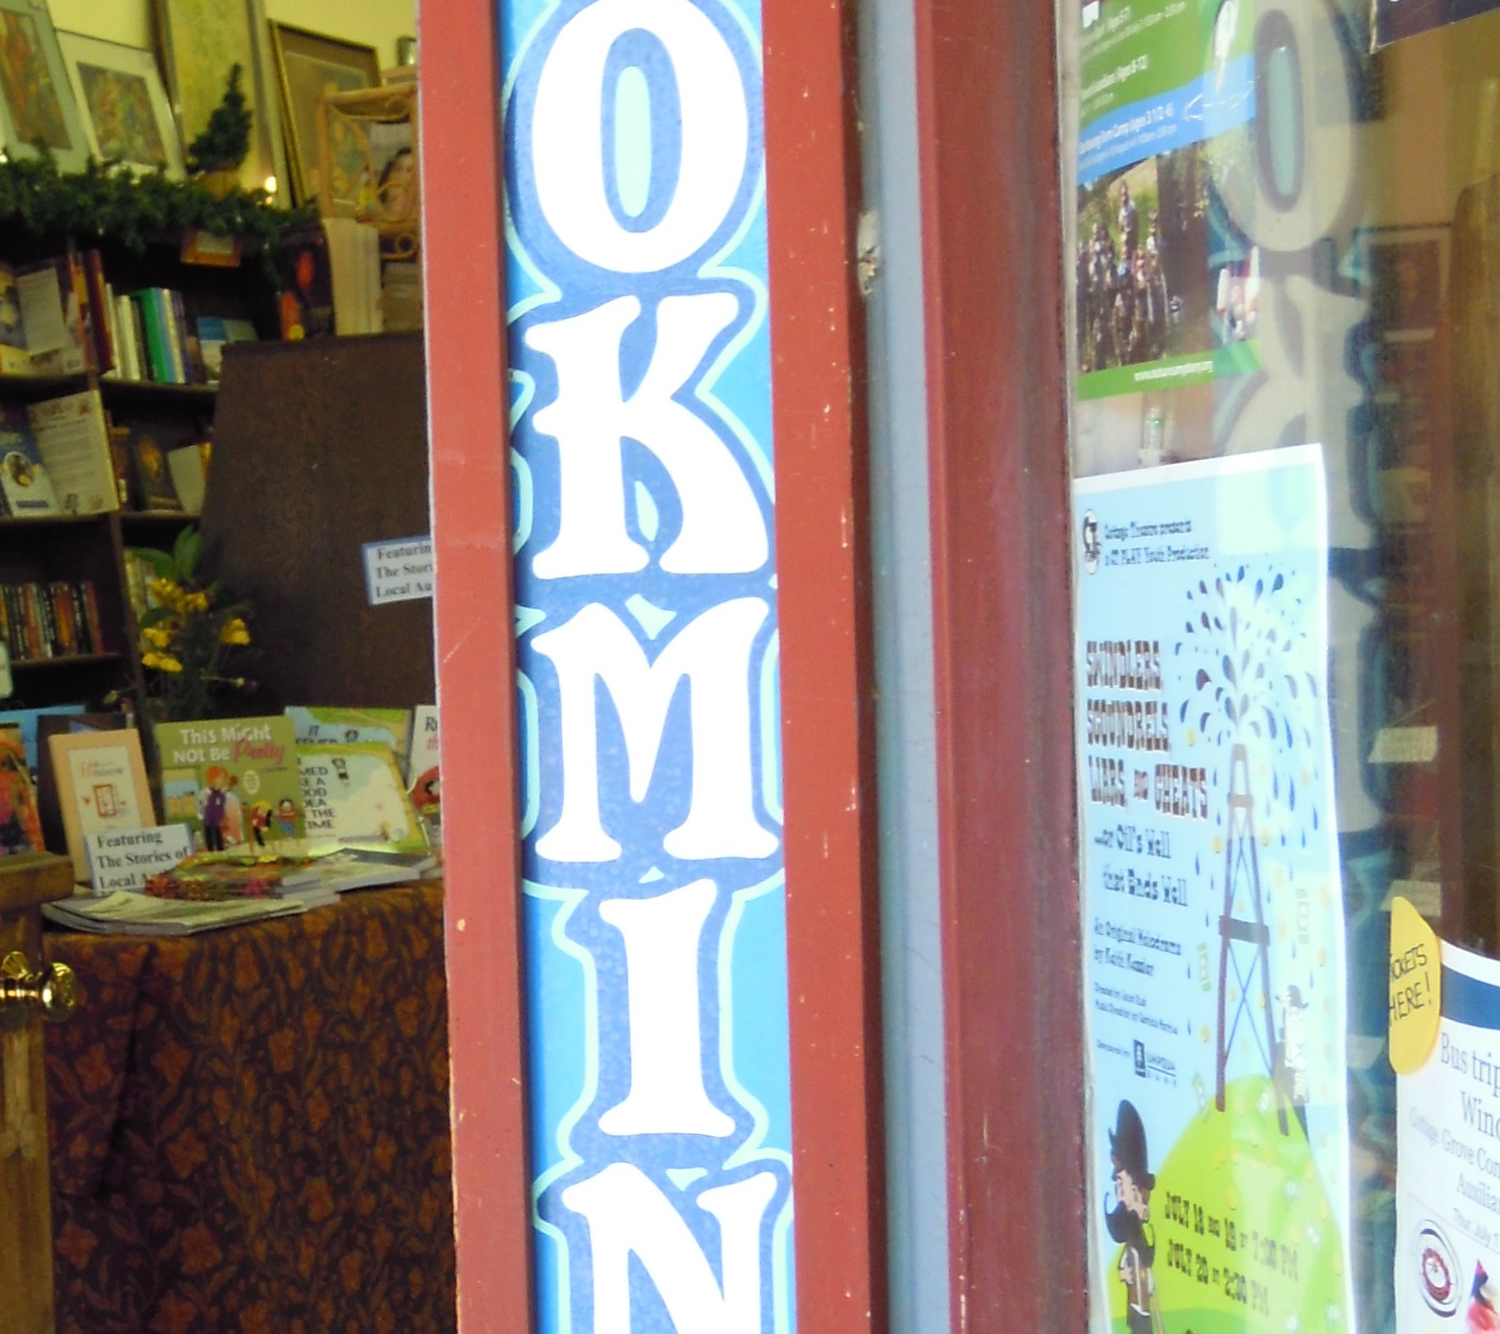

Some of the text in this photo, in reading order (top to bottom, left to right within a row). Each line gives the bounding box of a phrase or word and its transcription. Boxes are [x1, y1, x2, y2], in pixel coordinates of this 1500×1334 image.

[377, 543, 431, 560] Featurin
[180, 724, 272, 745] This Might
[97, 830, 163, 849] Featuring
[97, 854, 122, 870] The
[125, 850, 171, 866] Stories
[100, 875, 136, 890] Local
[1391, 943, 1428, 981] ICKETS
[1441, 1031, 1469, 1074] Bus
